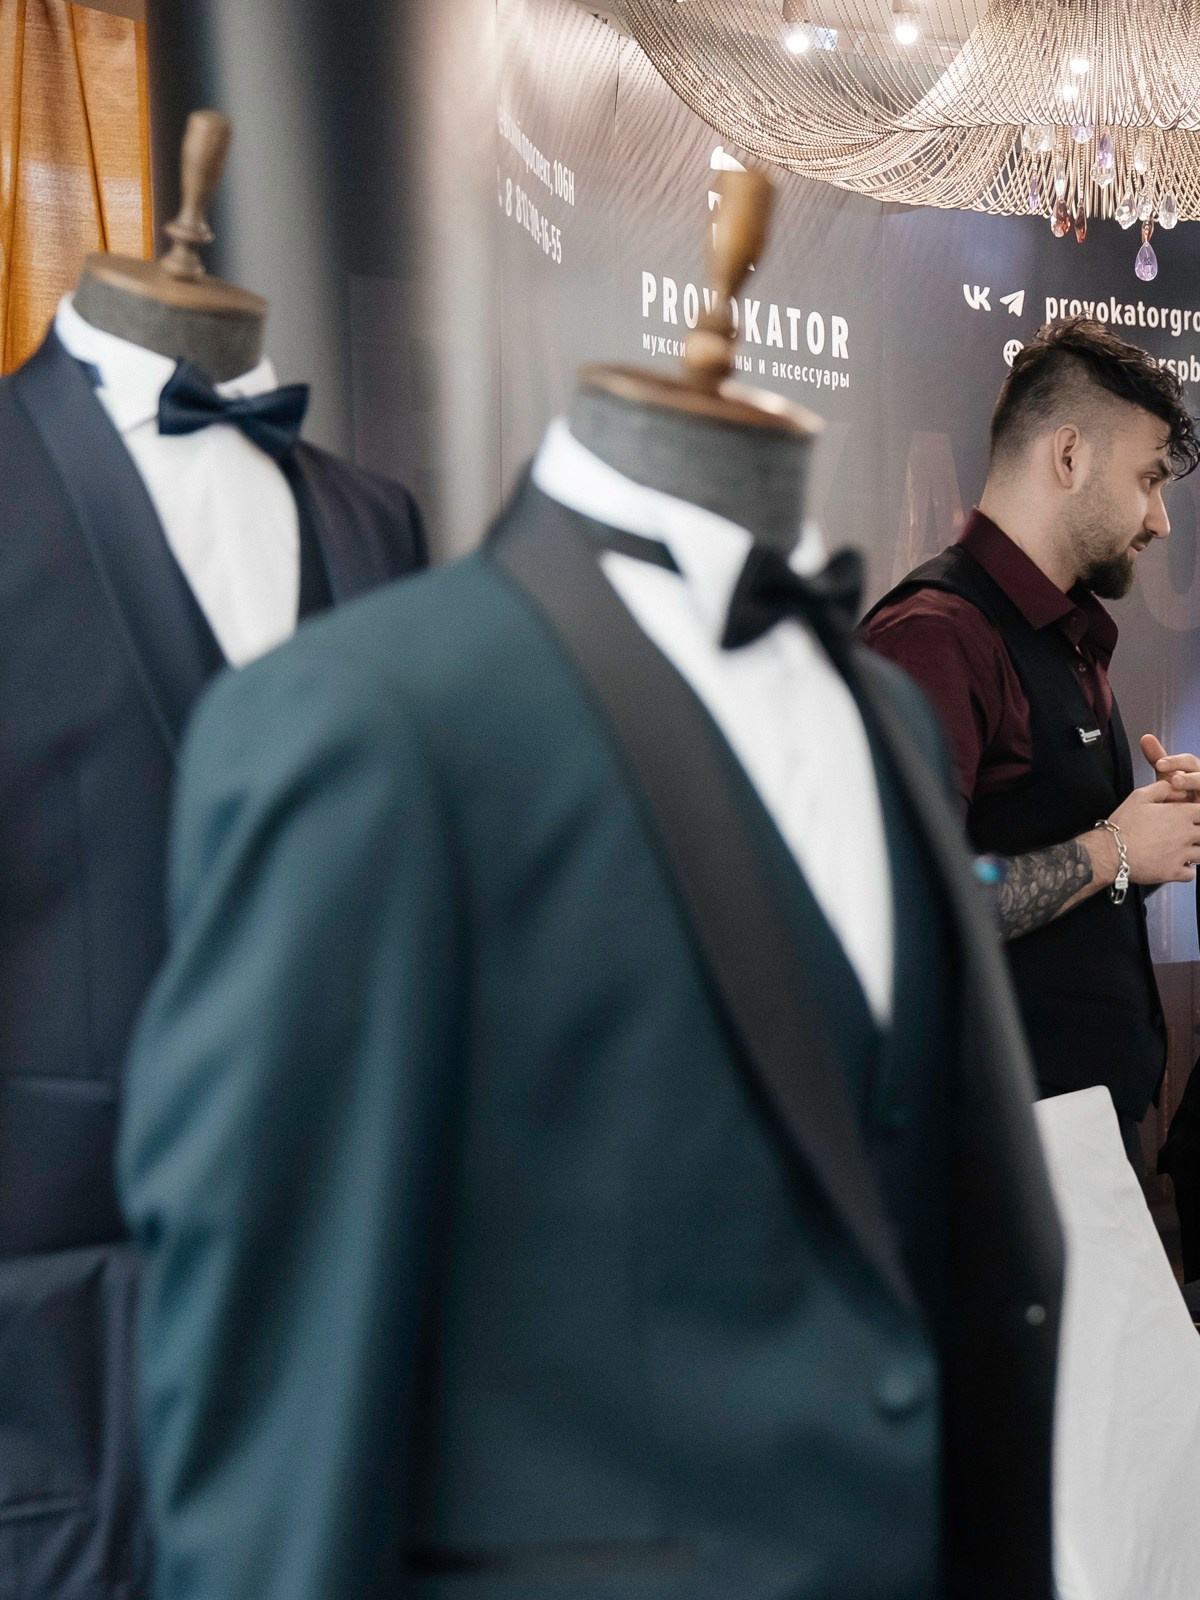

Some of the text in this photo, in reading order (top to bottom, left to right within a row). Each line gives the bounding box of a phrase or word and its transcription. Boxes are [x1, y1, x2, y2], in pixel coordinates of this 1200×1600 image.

[505, 178, 512, 217] 8
[642, 333, 686, 358] мужски
[758, 359, 766, 375] и
[772, 361, 850, 391] аксессуары
